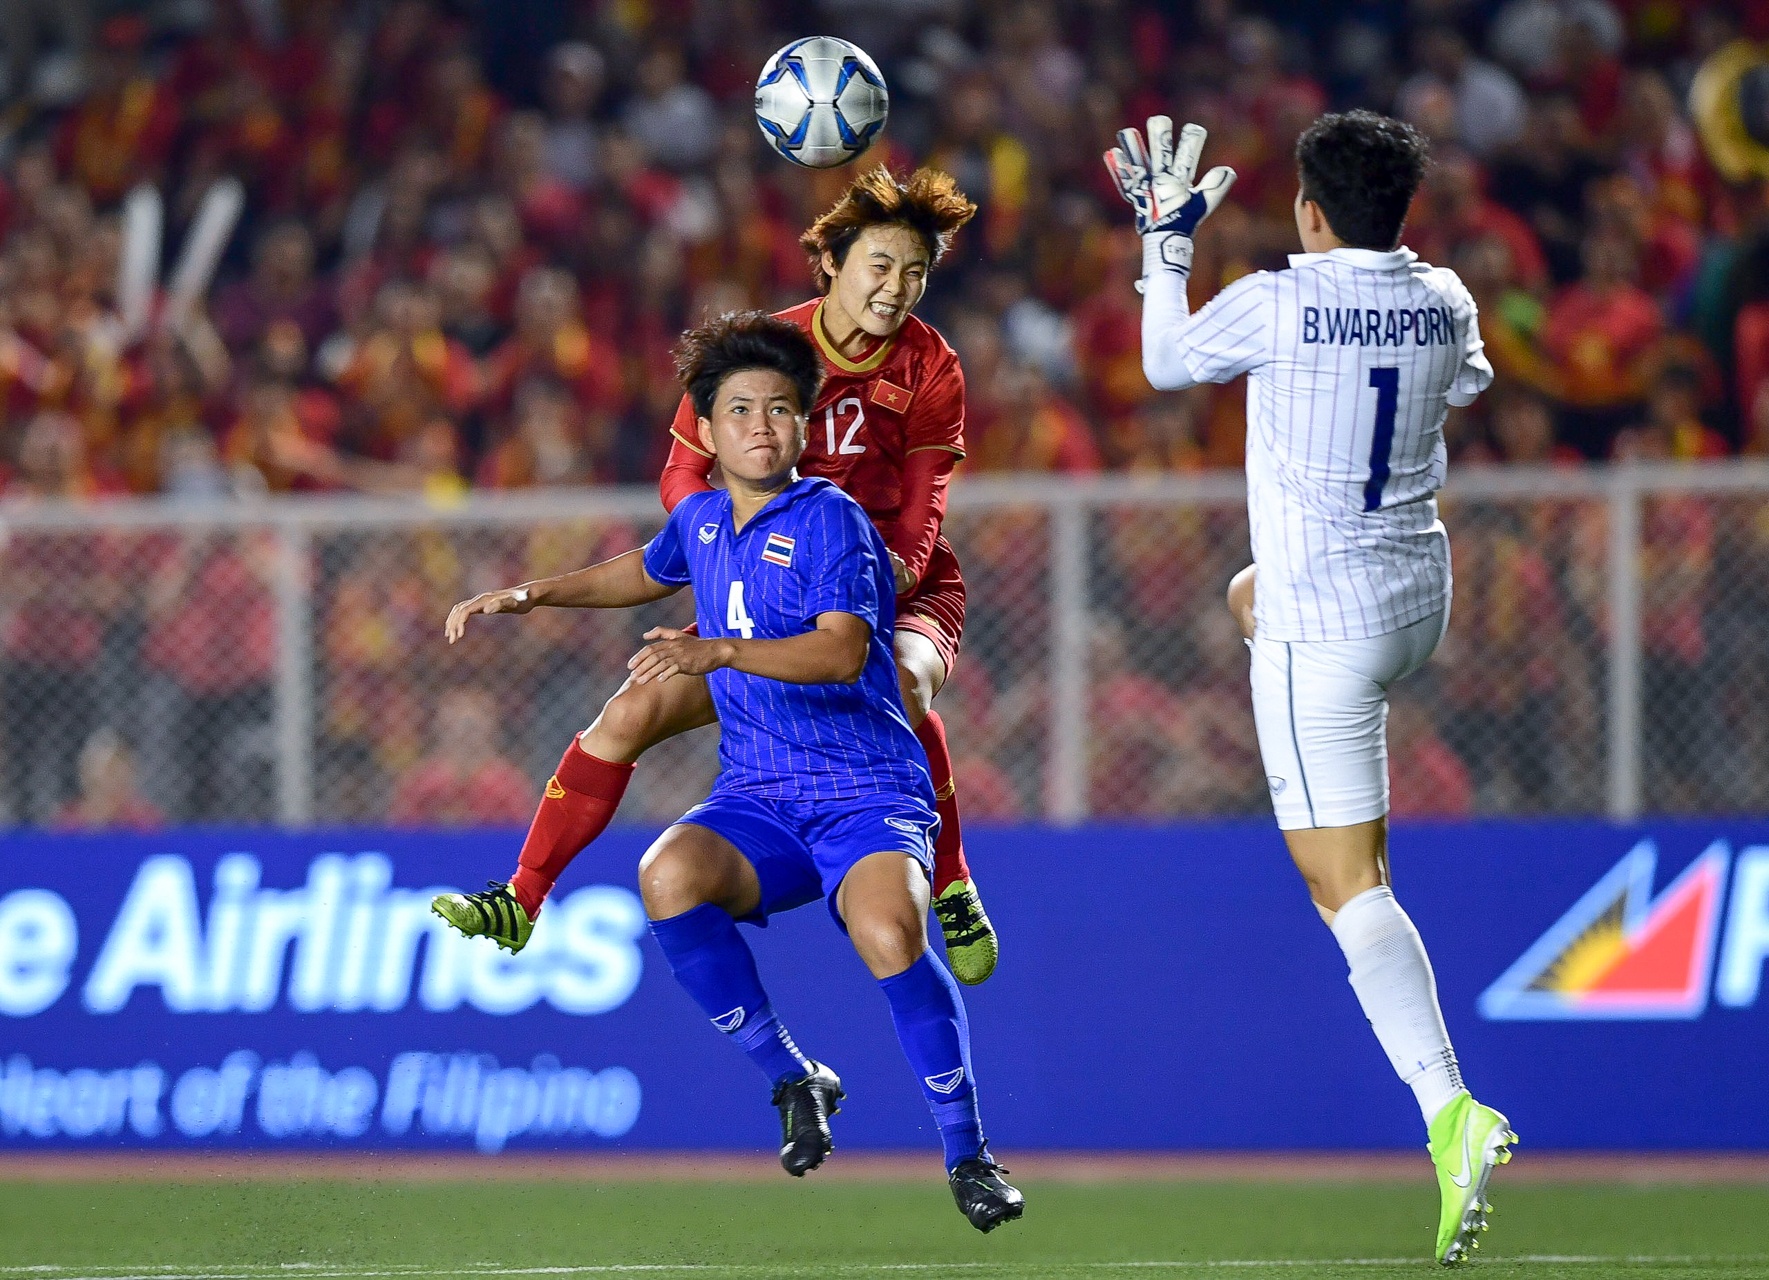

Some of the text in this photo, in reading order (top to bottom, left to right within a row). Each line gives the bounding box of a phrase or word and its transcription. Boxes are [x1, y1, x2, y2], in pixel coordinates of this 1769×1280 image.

[1303, 306, 1456, 347] B.WARAPORN
[824, 397, 867, 456] 12
[1363, 367, 1400, 512] 1
[727, 580, 755, 639] 4
[172, 1050, 262, 1138] of
[382, 1050, 642, 1154] Filipino
